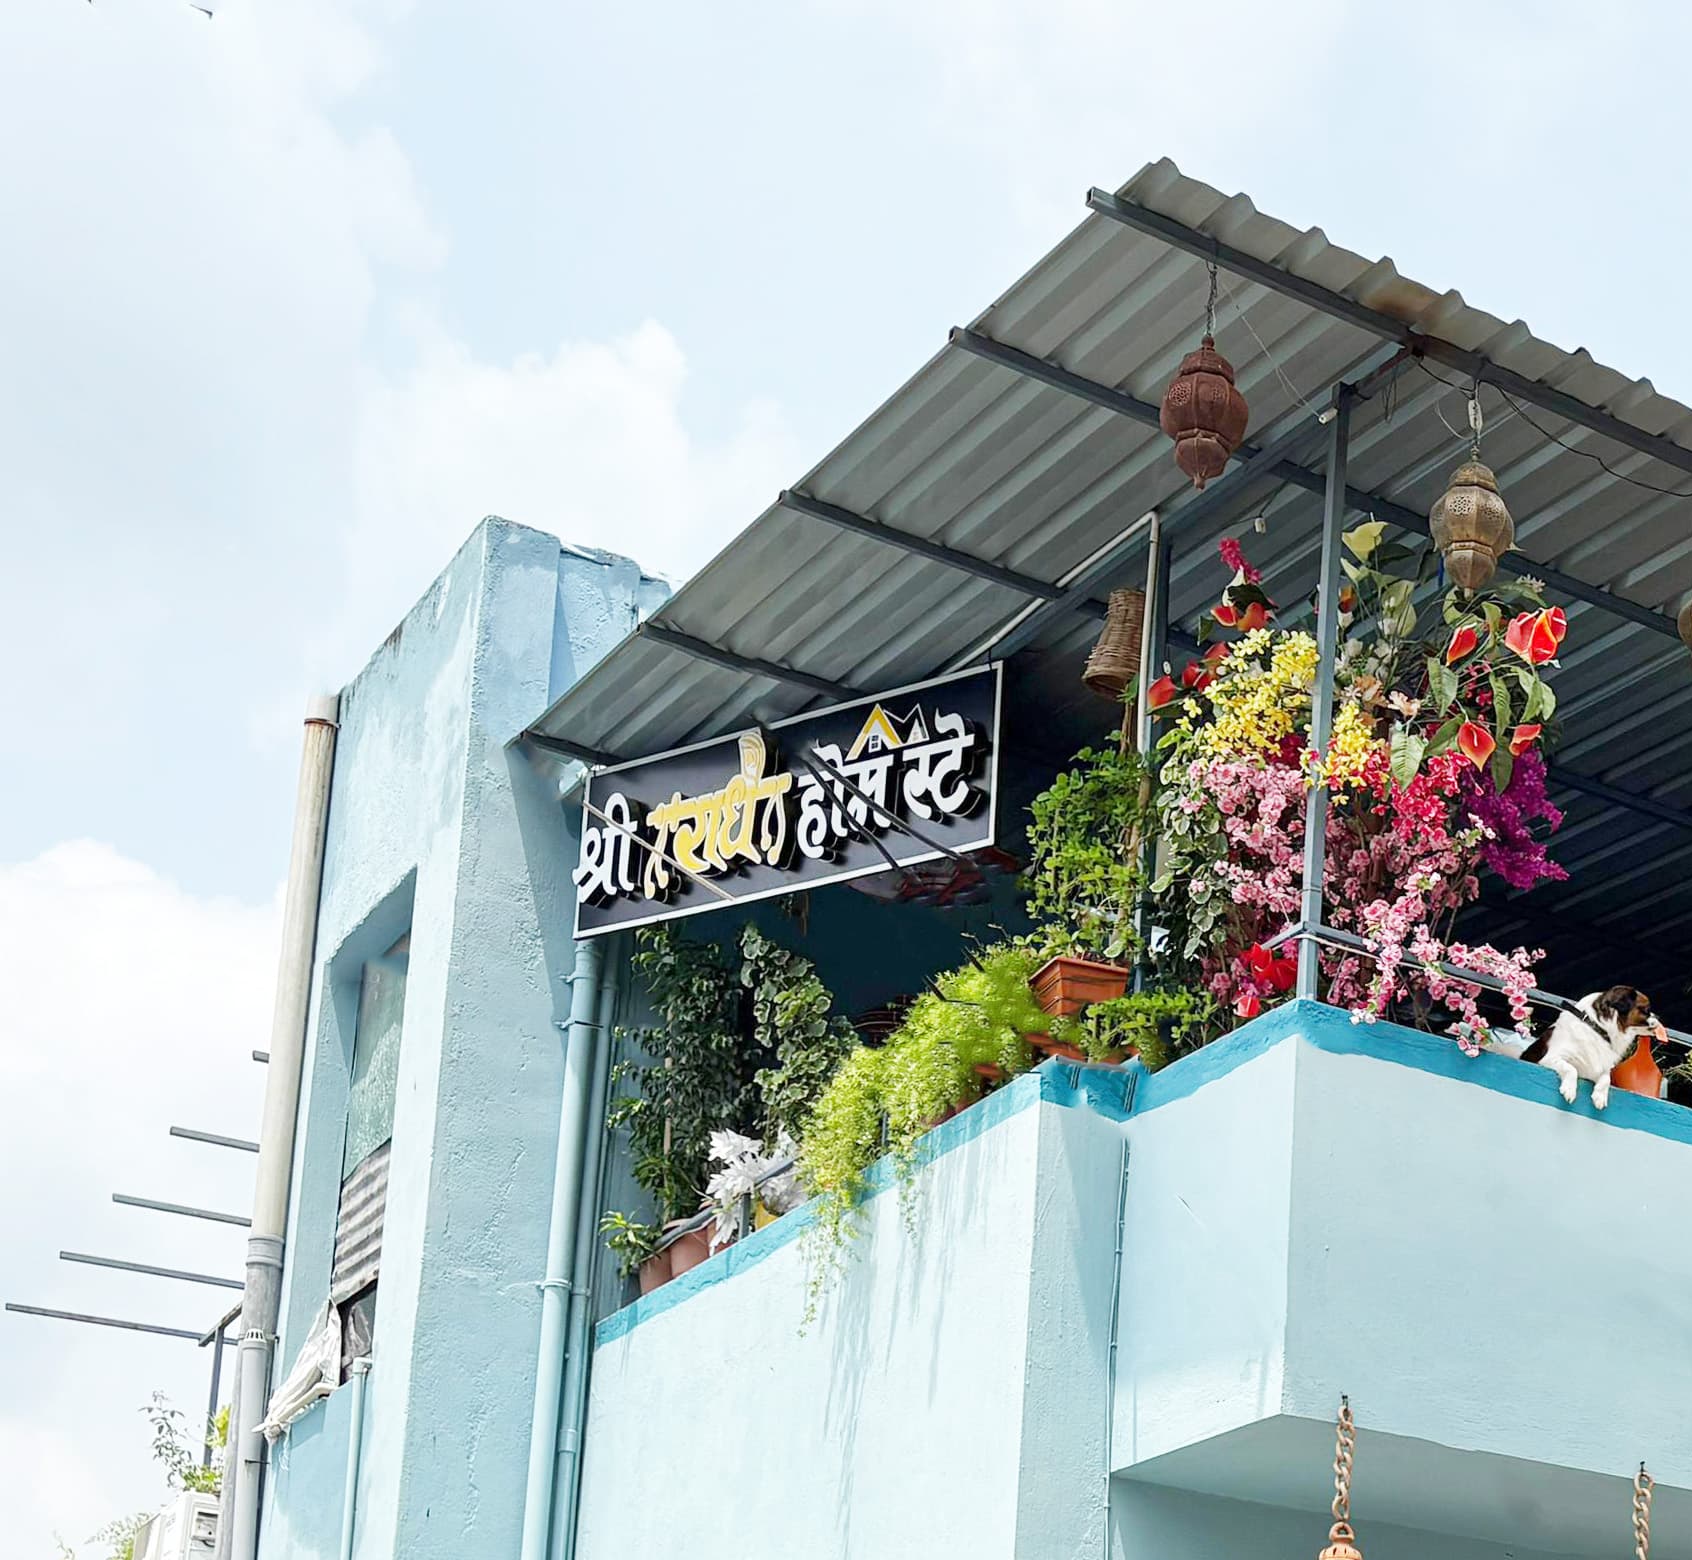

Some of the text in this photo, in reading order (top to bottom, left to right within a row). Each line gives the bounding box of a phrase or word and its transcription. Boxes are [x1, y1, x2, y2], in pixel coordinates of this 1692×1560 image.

[572, 792, 639, 904] श्री
[797, 739, 894, 859] होम
[902, 707, 976, 820] स्टे
